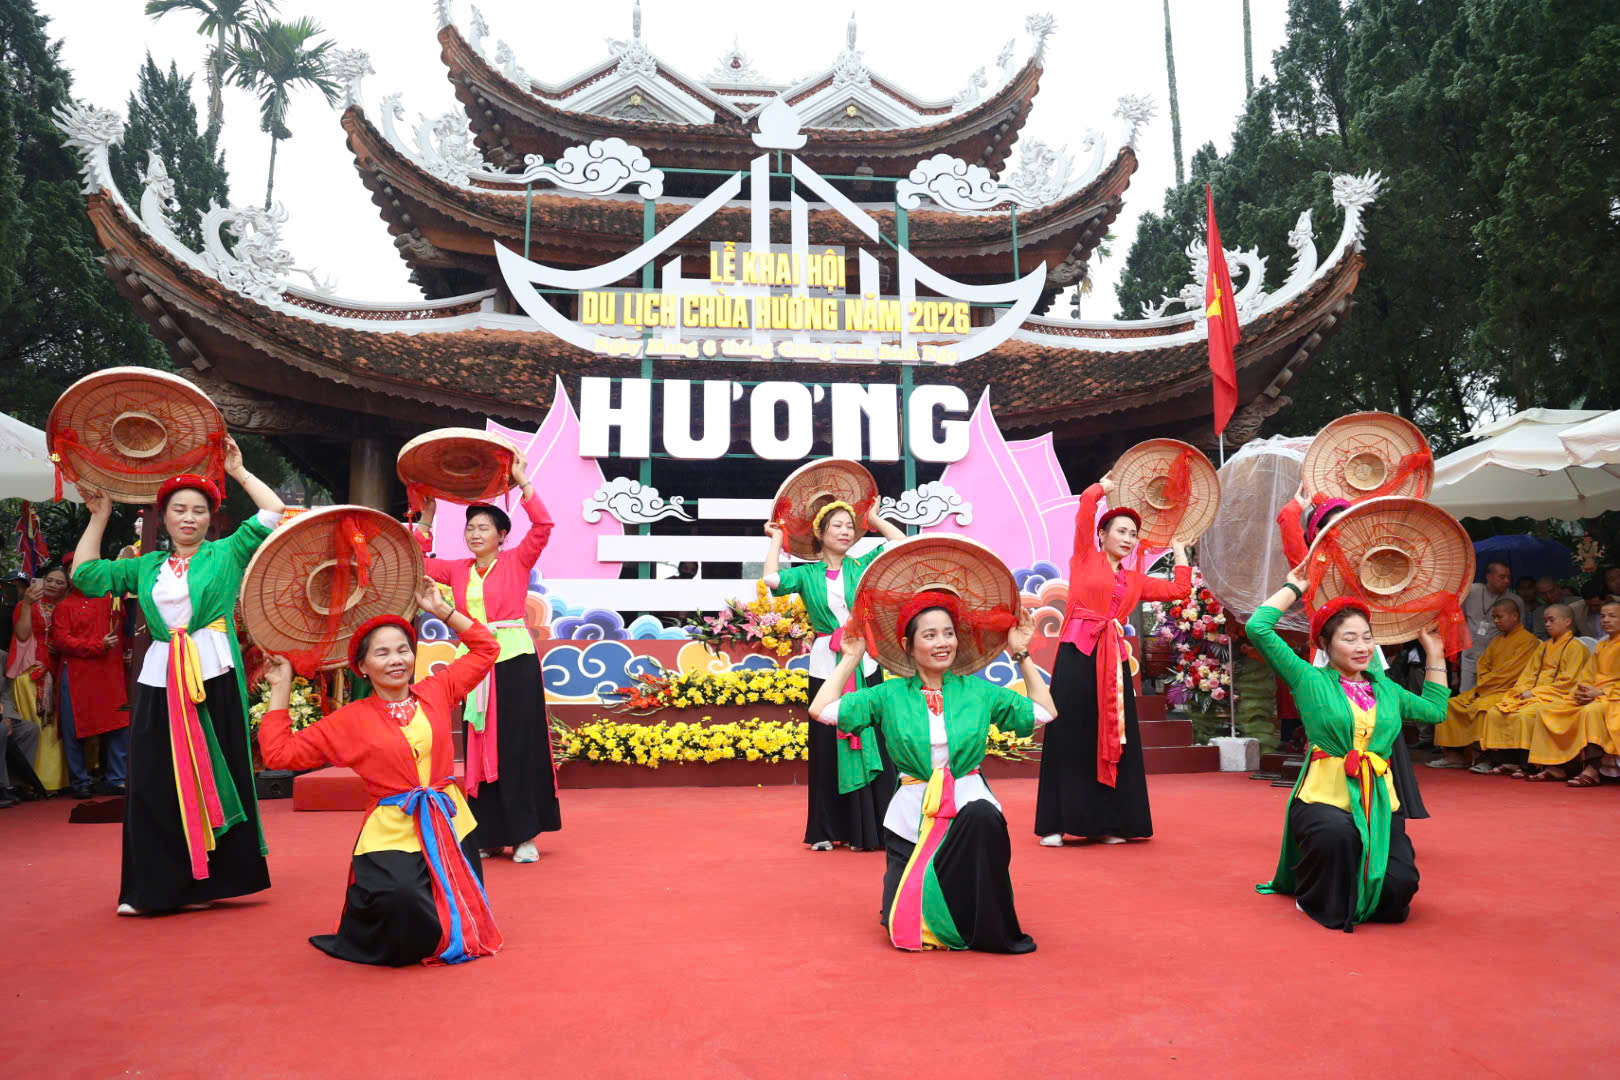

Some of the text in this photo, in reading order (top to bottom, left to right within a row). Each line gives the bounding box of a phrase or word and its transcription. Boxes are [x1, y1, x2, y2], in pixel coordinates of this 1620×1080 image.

[711, 241, 845, 293] LỄ KHAI HỘI
[582, 288, 971, 334] DU LỊCH CHÙA HƯƠNG NĂM 2026
[579, 376, 971, 463] HƯƠNG
